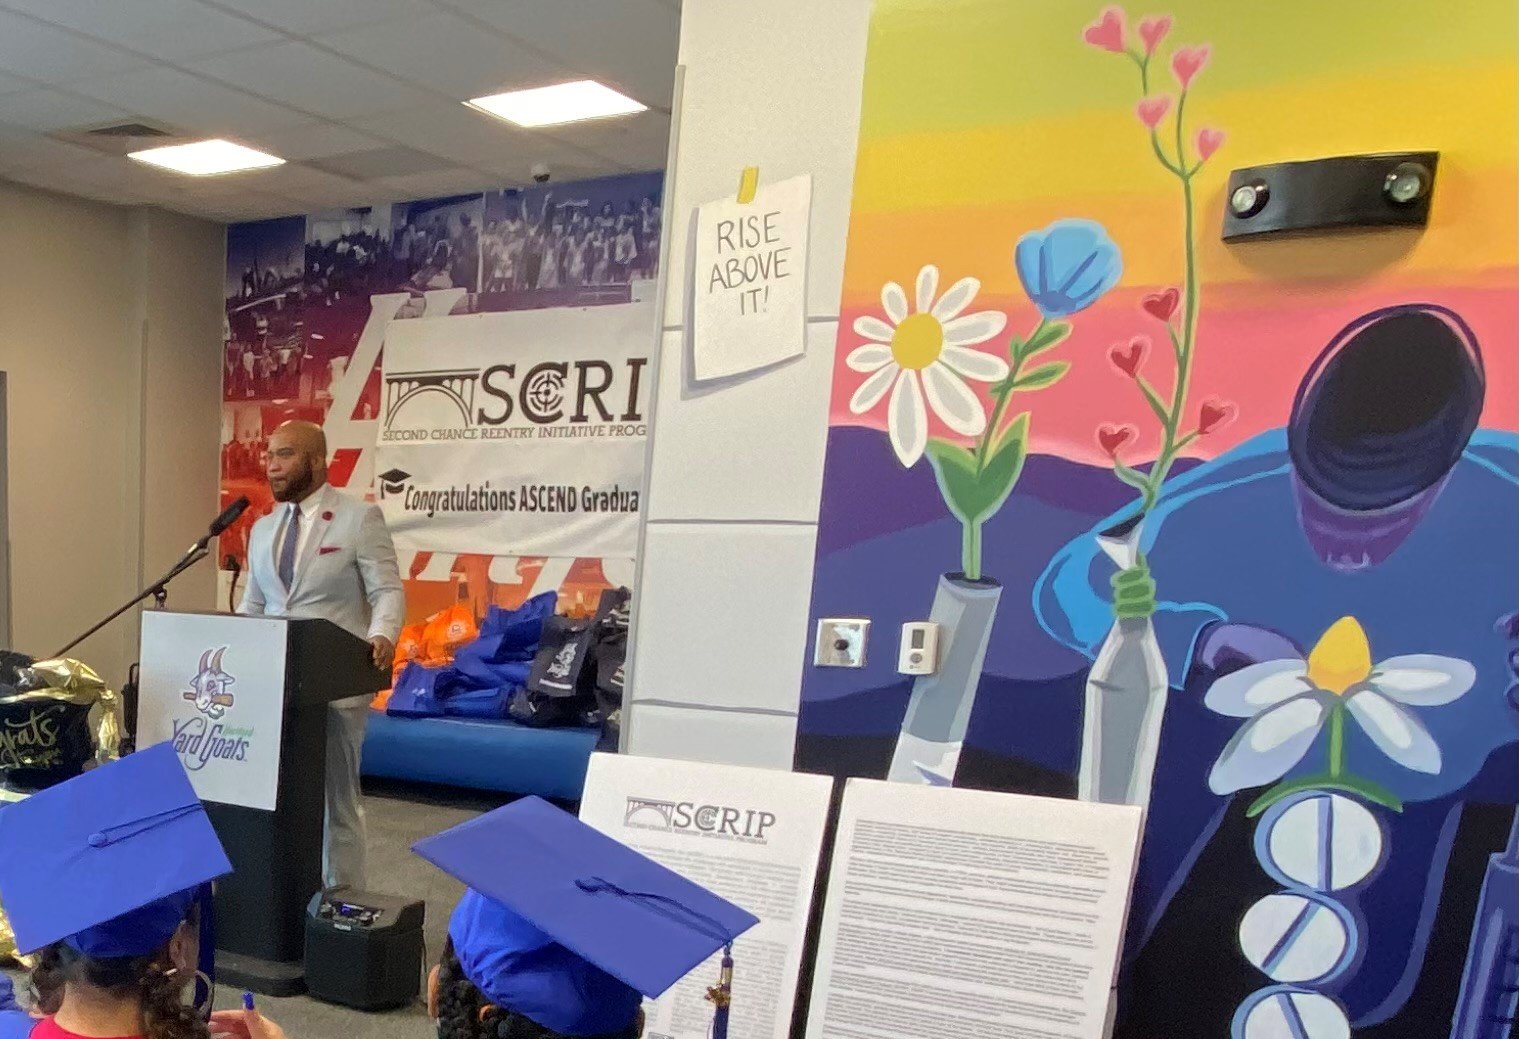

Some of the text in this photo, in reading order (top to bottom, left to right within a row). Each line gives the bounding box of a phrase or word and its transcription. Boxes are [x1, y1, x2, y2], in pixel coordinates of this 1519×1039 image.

[717, 211, 781, 254] RISE
[709, 246, 792, 294] ABOVE
[740, 285, 769, 315] IT!
[477, 358, 647, 425] SCRI
[382, 424, 647, 441] SECOND CHANCE REENTRY INITIATIVE PROG
[405, 481, 639, 518] Congratulations ASCEND Gradua
[172, 717, 249, 770] Yard Goats
[673, 801, 776, 839] SCRIP
